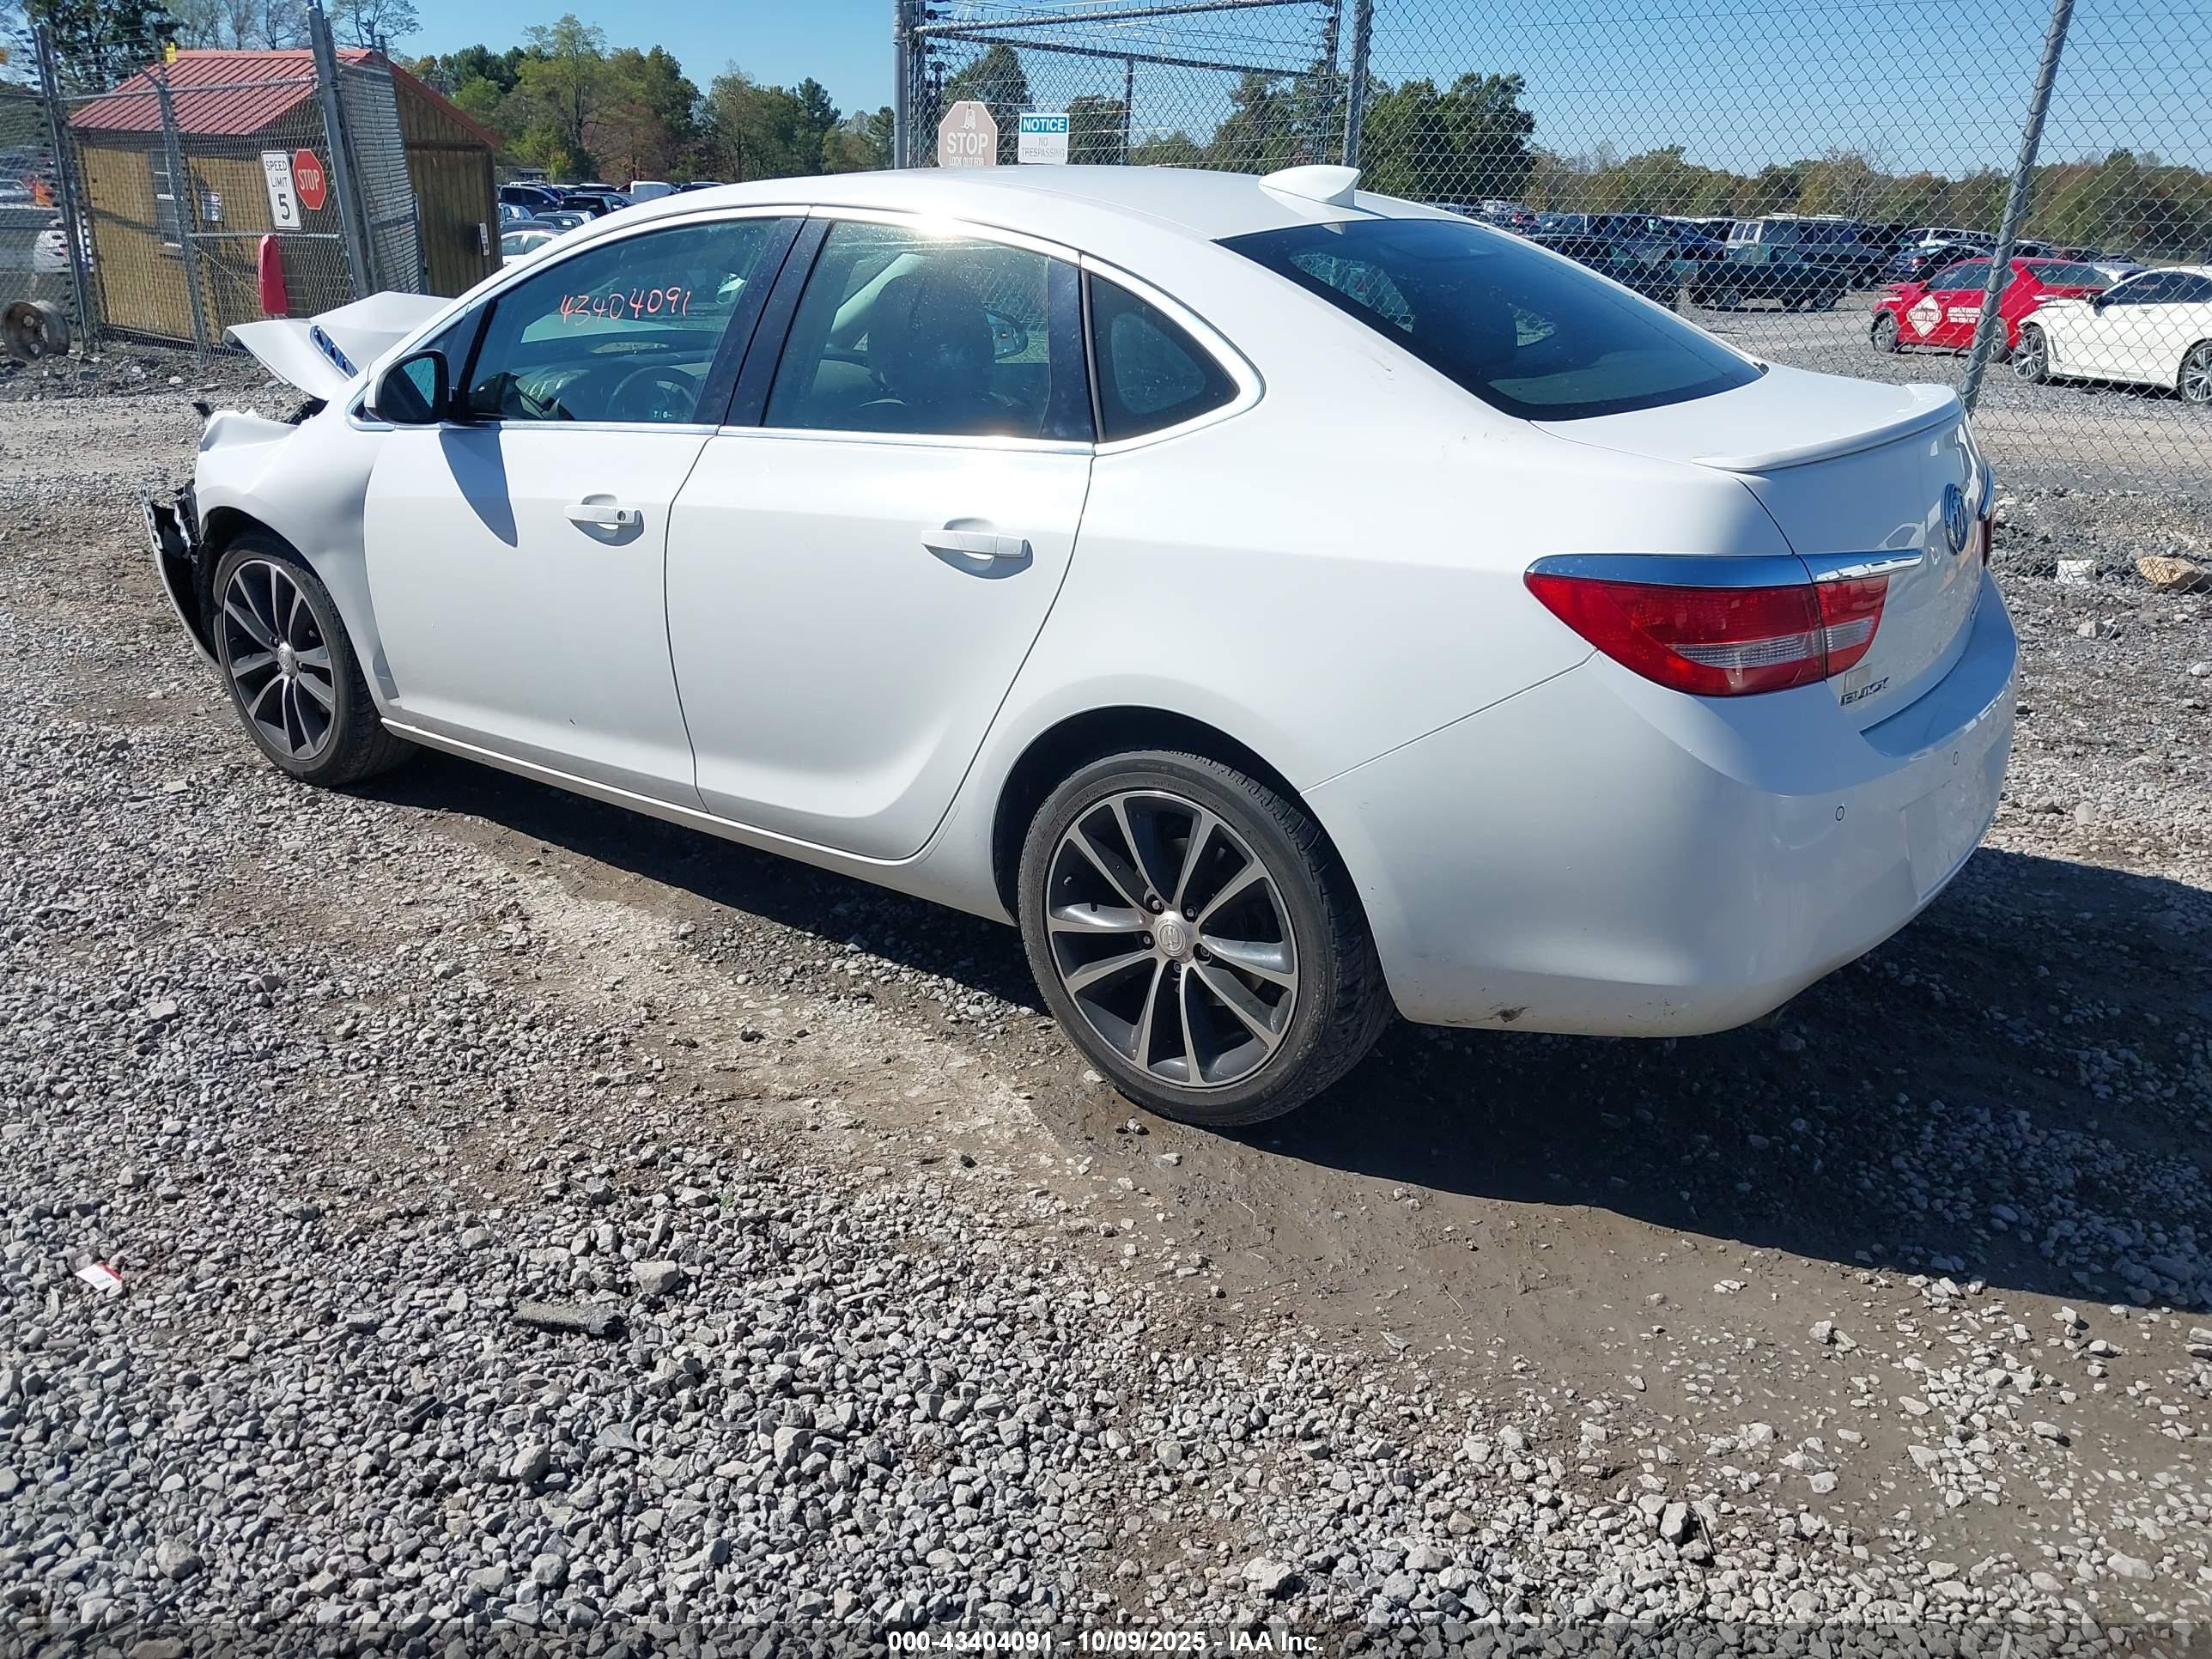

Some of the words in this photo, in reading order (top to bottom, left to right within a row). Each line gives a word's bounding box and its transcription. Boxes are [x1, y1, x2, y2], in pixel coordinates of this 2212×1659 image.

[1023, 118, 1066, 131] NOTICE
[946, 132, 988, 155] STOP
[1038, 137, 1048, 147] NO
[1021, 147, 1065, 158] TRESPASSING
[265, 161, 288, 172] SPEED
[949, 156, 962, 167] LOOK
[963, 157, 973, 167] OUT
[974, 157, 984, 167] FOR
[270, 177, 288, 188] LIMIT
[297, 168, 320, 191] STOP
[278, 193, 291, 221] 5
[559, 286, 692, 327] 43404091
[1839, 676, 1890, 707] BUICK
